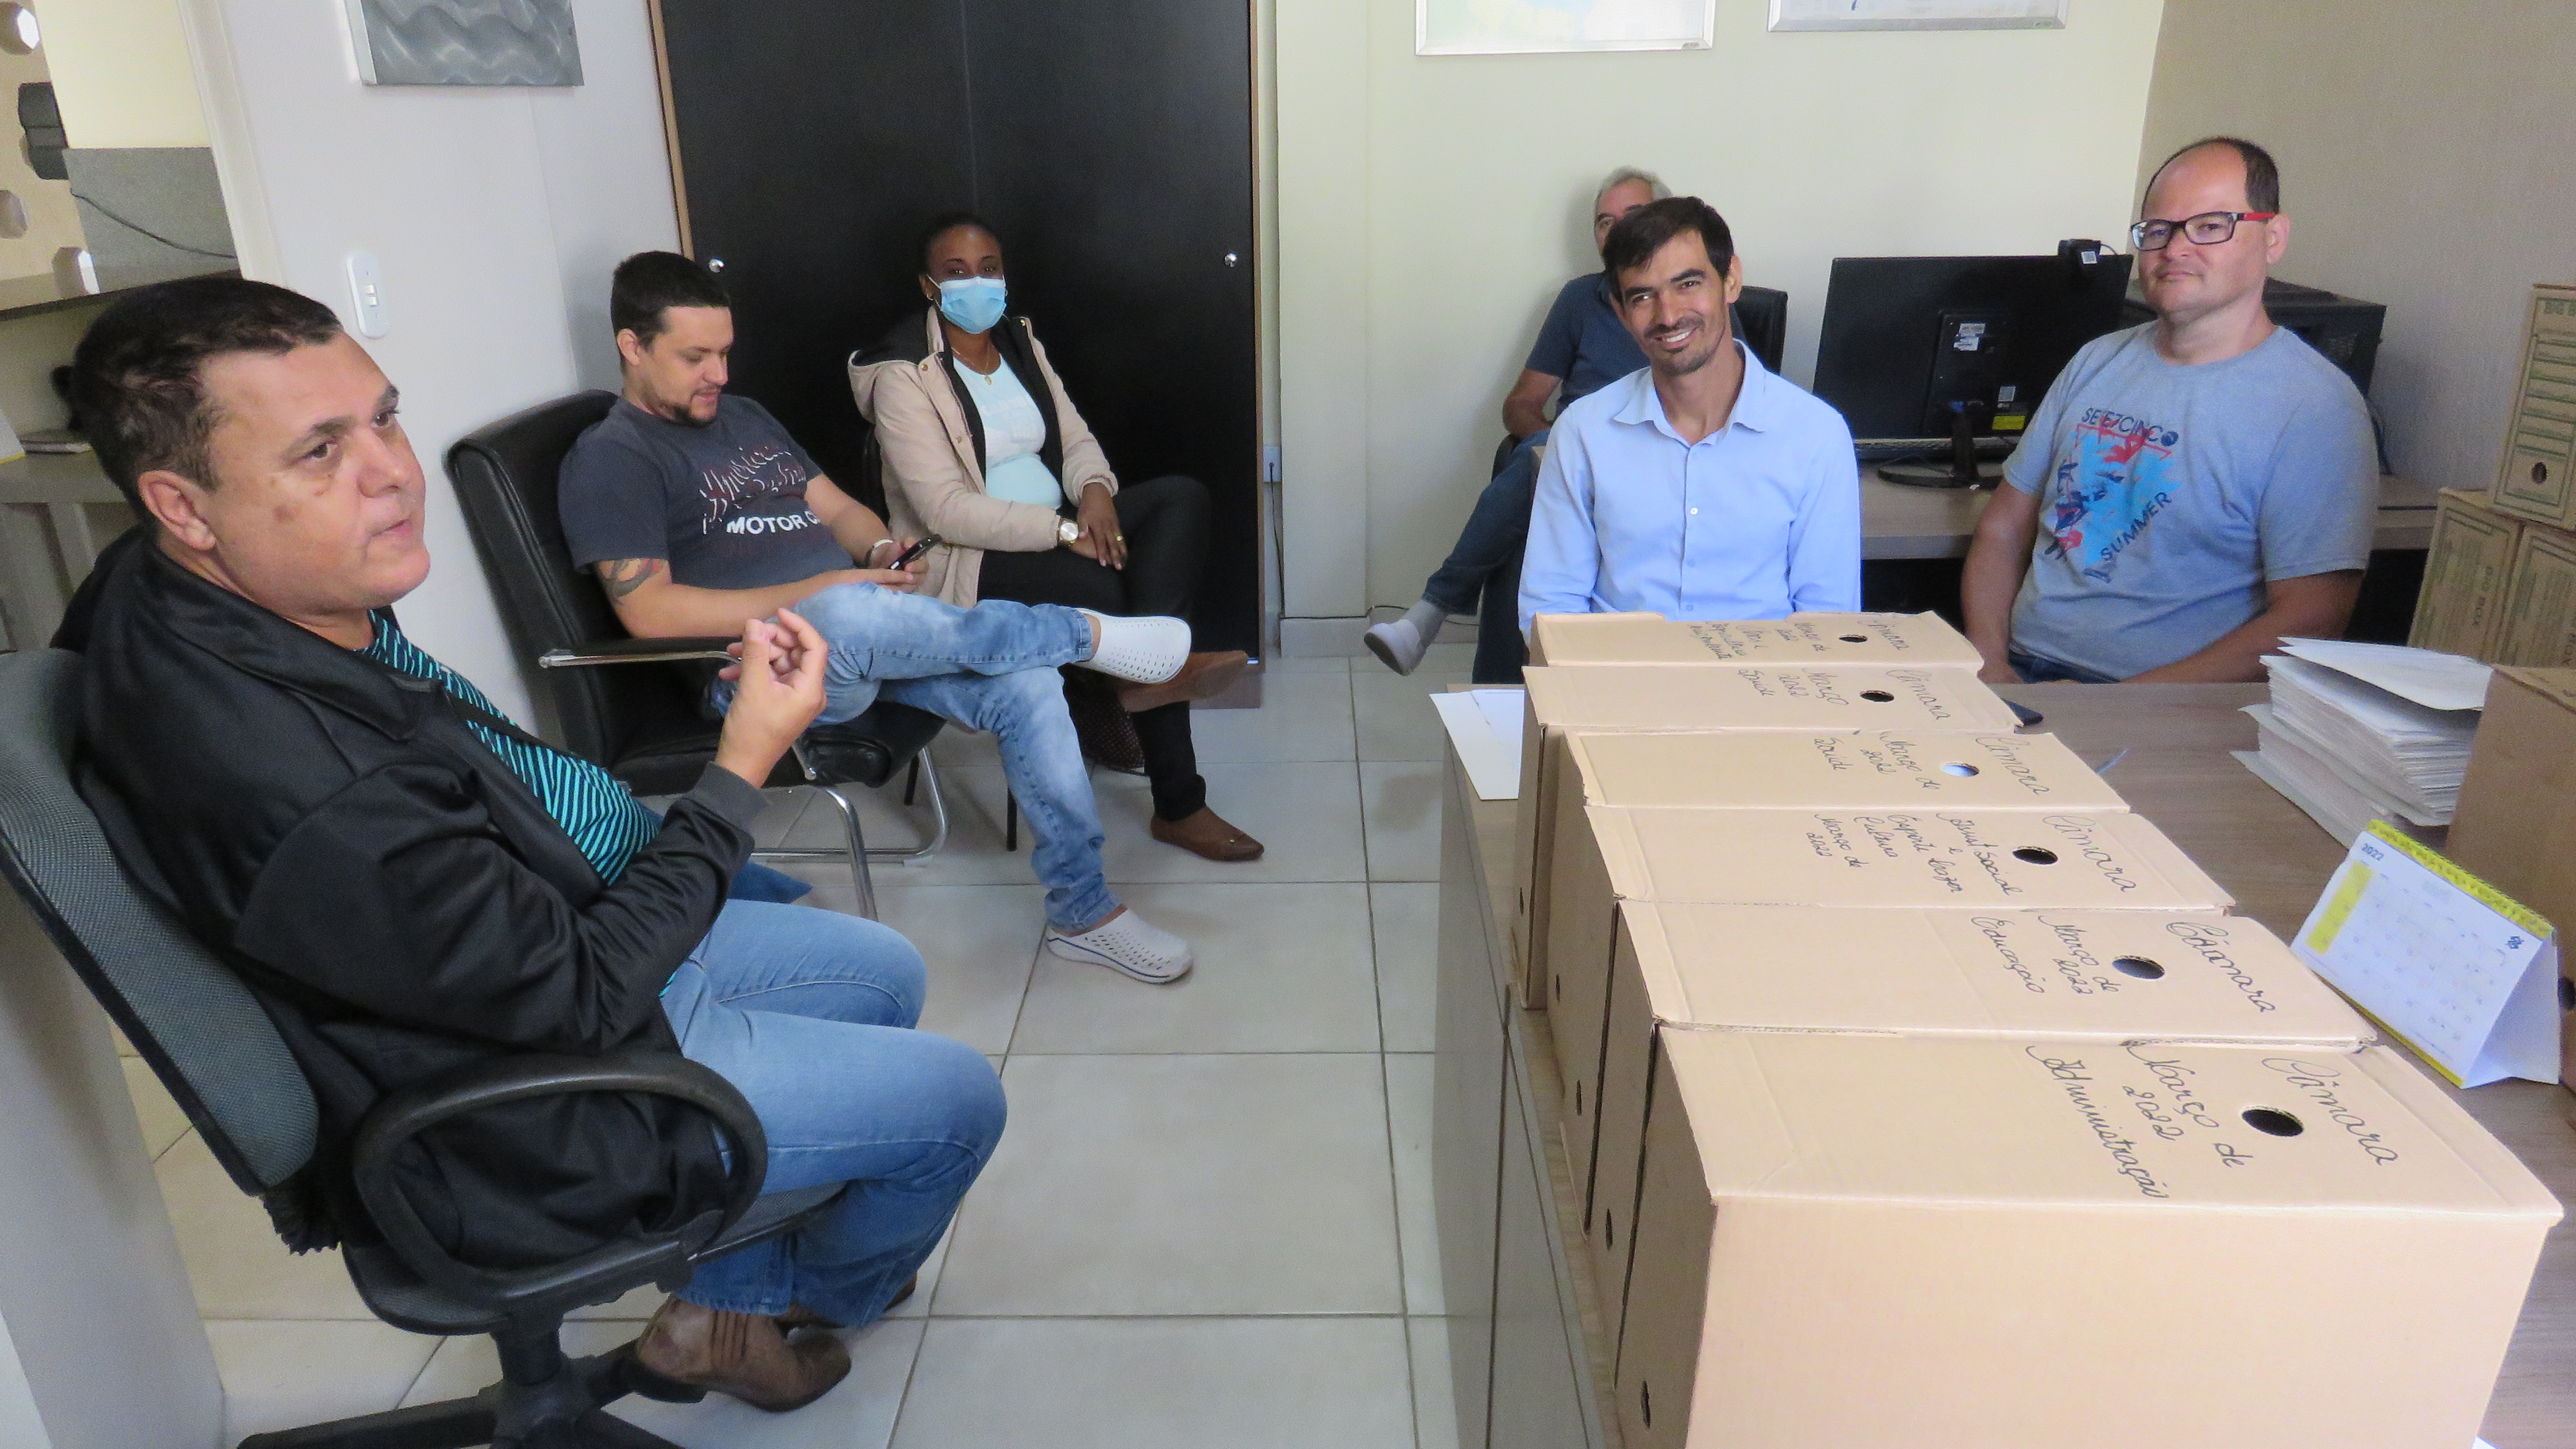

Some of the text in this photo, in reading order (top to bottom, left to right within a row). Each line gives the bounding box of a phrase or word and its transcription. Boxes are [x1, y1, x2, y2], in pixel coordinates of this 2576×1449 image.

[726, 514, 808, 534] MOTOR
[2100, 491, 2172, 560] SUMMER
[1777, 674, 1810, 698] 2022
[1860, 749, 1898, 775] 2022
[1915, 776, 1941, 790] de
[1806, 831, 1833, 858] 2022
[2361, 843, 2385, 861] 2022
[1844, 855, 1869, 868] de
[2038, 915, 2121, 993] Março de
[2052, 958, 2094, 995] 2022
[2122, 1085, 2185, 1142] 2022
[2126, 1045, 2254, 1168] Março de
